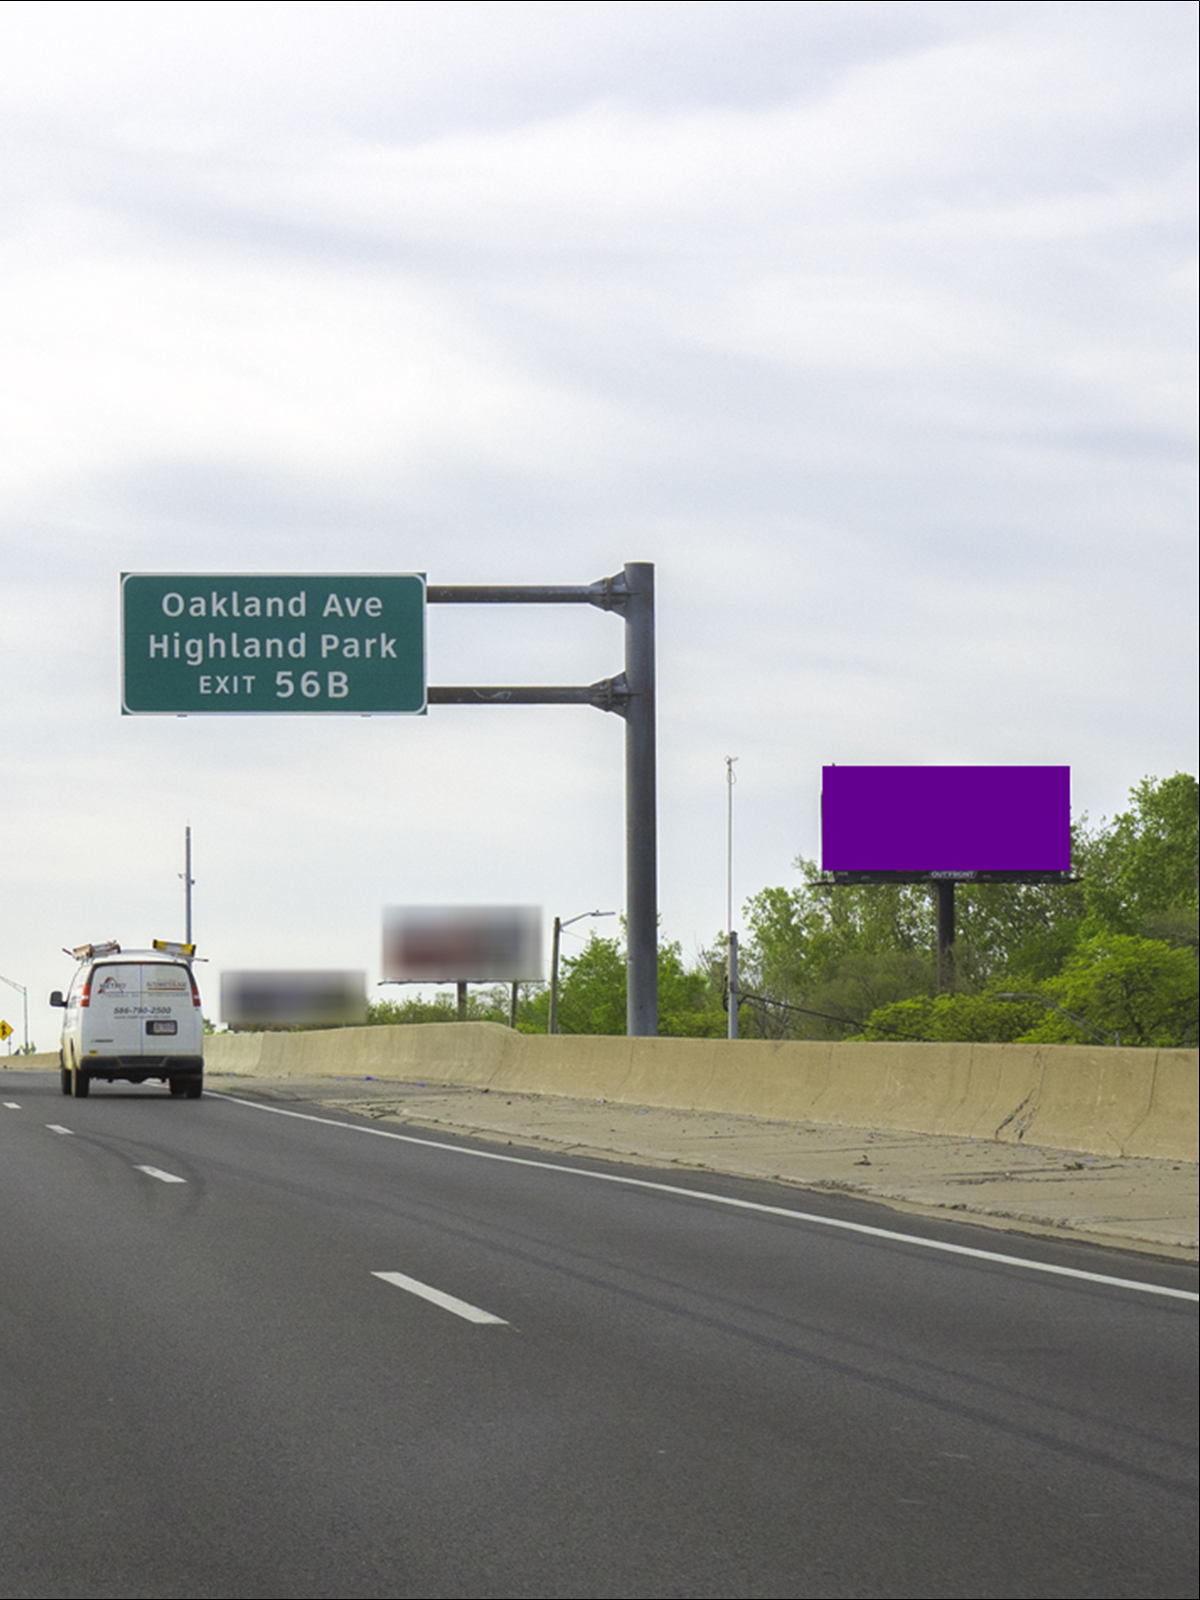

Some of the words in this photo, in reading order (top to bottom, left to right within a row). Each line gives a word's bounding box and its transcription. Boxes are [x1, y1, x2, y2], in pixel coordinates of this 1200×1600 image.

[161, 591, 306, 617] Oakland
[322, 593, 383, 617] Ave
[149, 632, 306, 666] Highland
[321, 632, 398, 658] Park
[199, 675, 256, 694] EXIT
[275, 671, 350, 698] 56B
